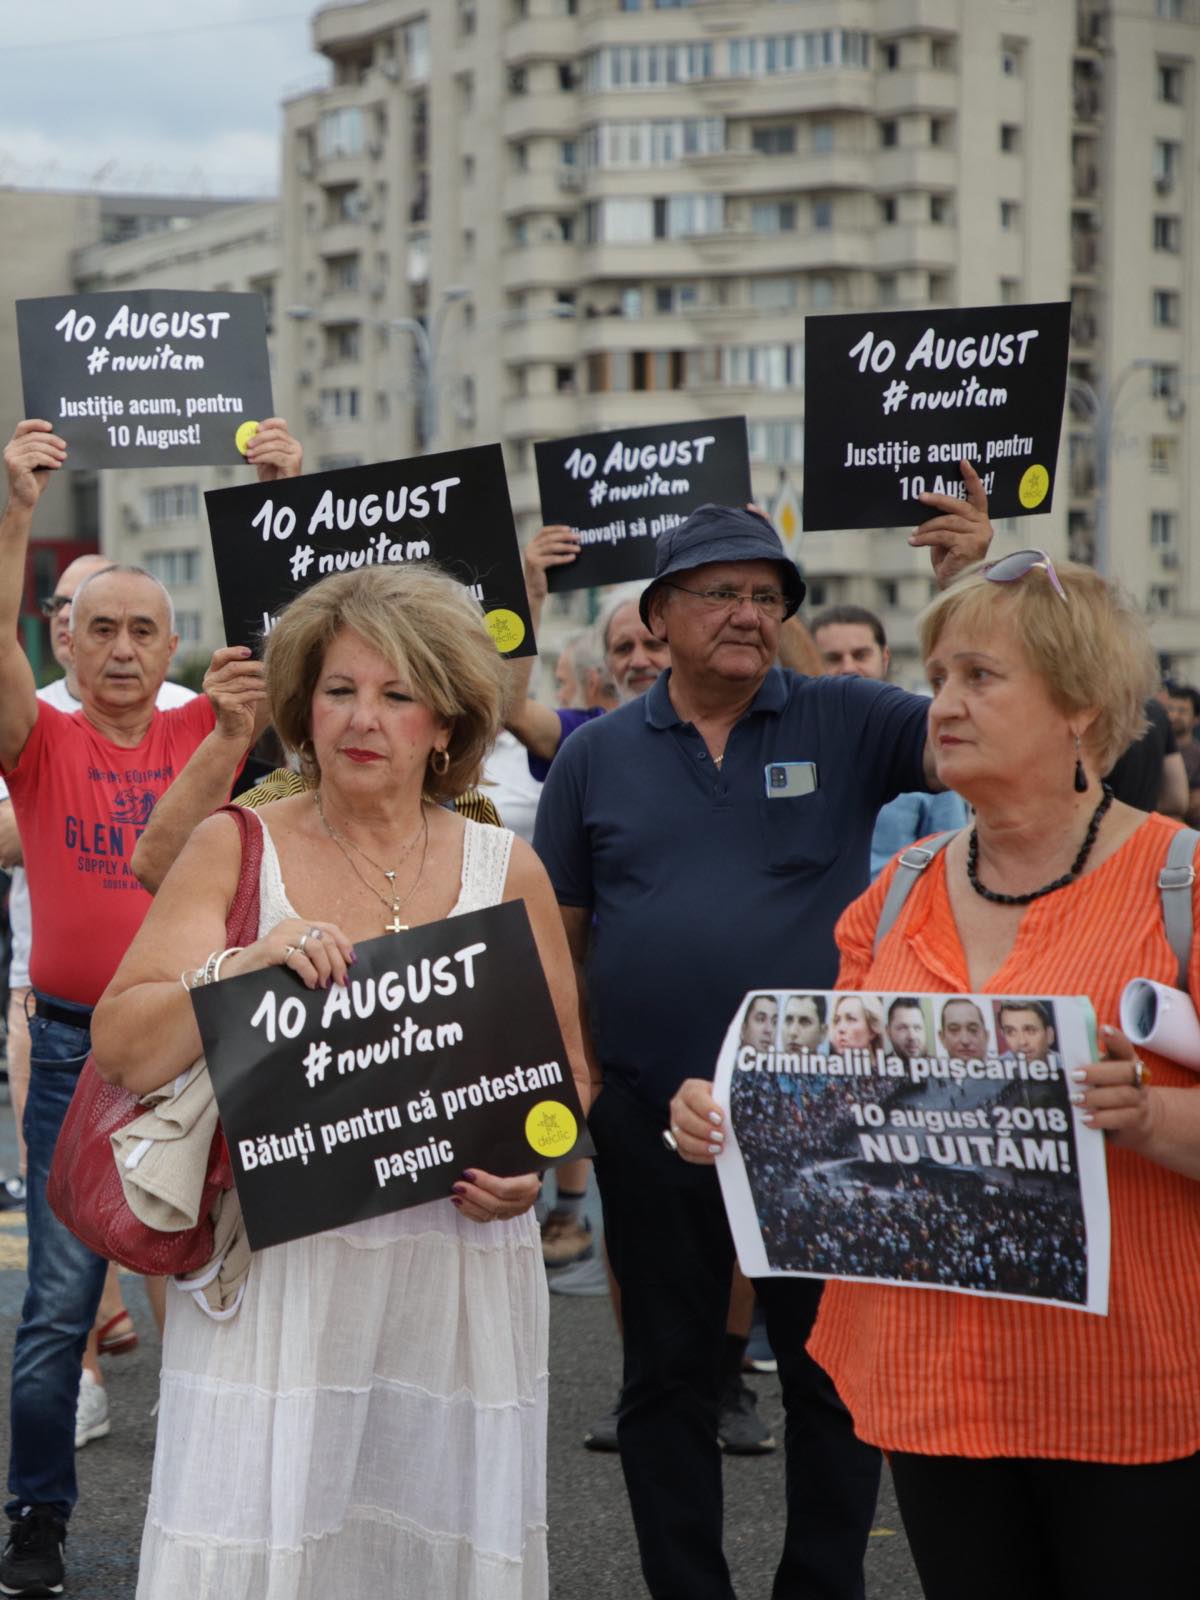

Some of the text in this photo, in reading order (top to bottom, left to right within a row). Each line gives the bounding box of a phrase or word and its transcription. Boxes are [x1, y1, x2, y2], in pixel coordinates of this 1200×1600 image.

[55, 305, 230, 341] 10 AUGUST
[87, 344, 204, 375] #nuuitam
[849, 328, 1038, 372] 10 AUGUST
[60, 394, 242, 422] Justiție acum, pentru
[883, 376, 1007, 415] #nuuitam
[108, 424, 200, 448] 10 August!
[845, 435, 1033, 472] Justiție acum, pentru
[565, 437, 715, 478] 10 AUGUST
[589, 472, 690, 507] #nuuitam
[900, 471, 995, 501] 10 Augt!
[252, 477, 460, 541] 10 AUGUST
[630, 518, 647, 536] să
[288, 531, 430, 582] #nuuitam
[65, 815, 124, 857] GLEN
[77, 856, 118, 876] SUPPLY
[250, 942, 487, 1043] 10 AUGUST
[302, 1017, 464, 1088] #nuuitam
[737, 1045, 1060, 1084] Criminalii la pușcărie!
[238, 1061, 564, 1172] Bătuți pentru că protestam
[850, 1104, 1068, 1133] 10 august 2018
[373, 1137, 455, 1188] pașnic
[858, 1130, 1072, 1174] NU UITĂM!
